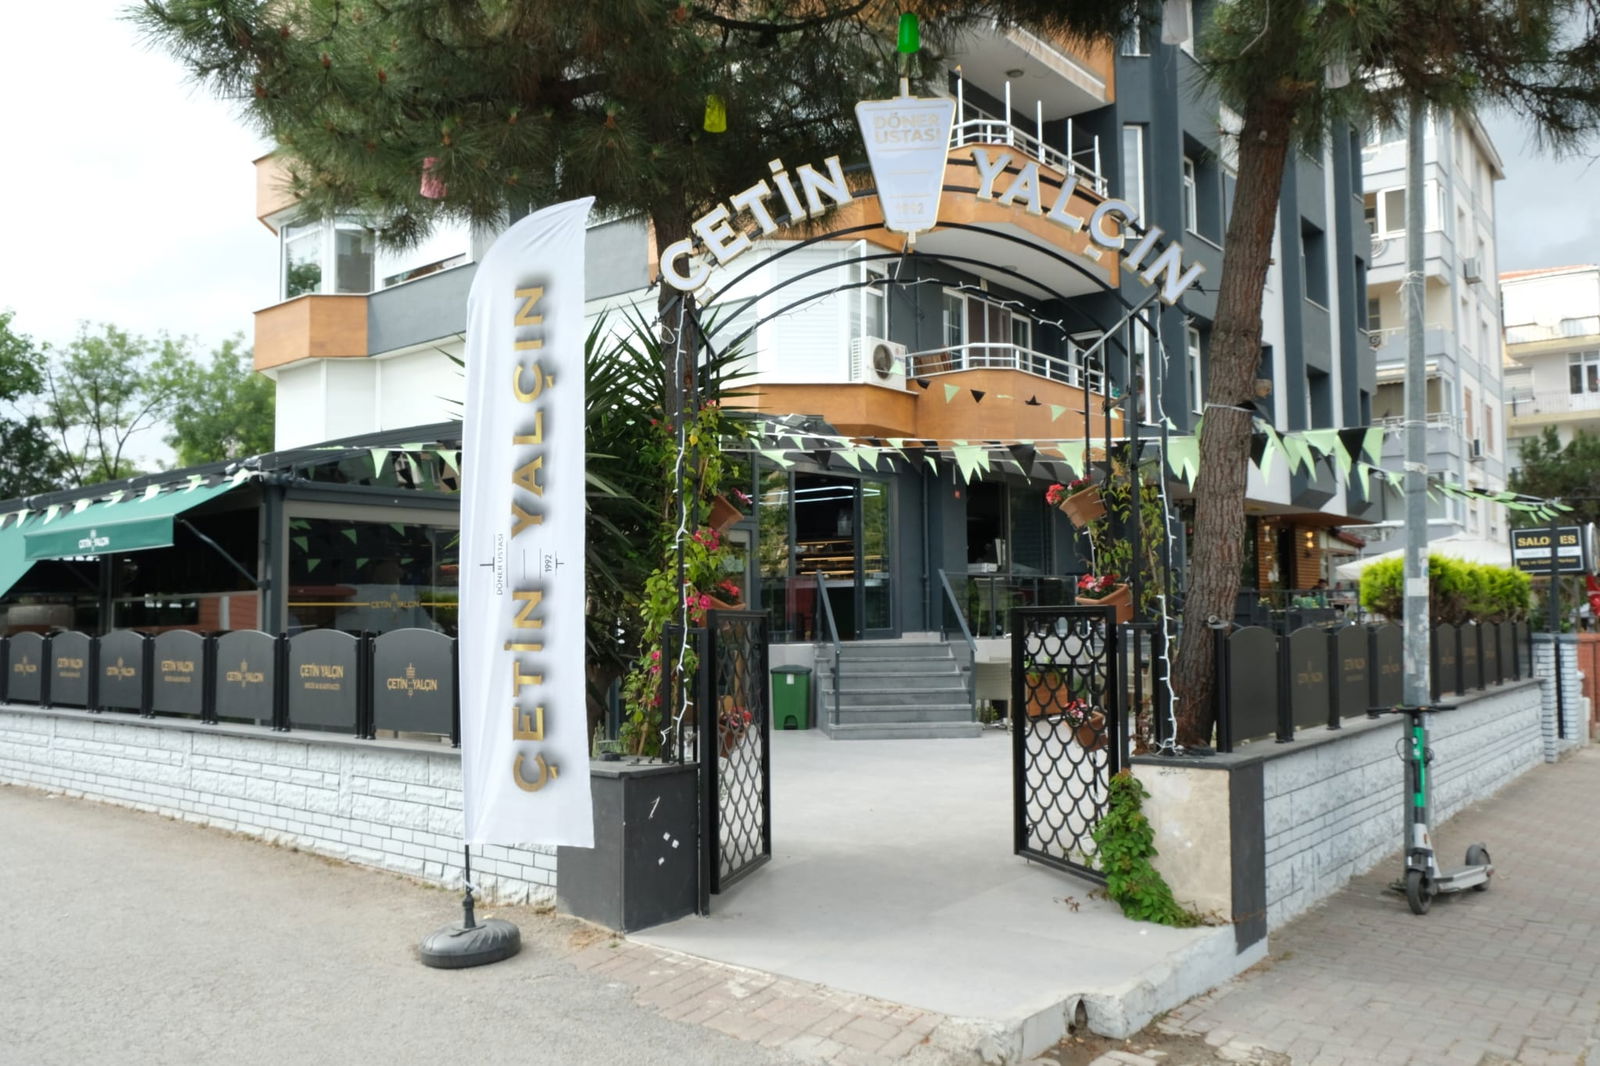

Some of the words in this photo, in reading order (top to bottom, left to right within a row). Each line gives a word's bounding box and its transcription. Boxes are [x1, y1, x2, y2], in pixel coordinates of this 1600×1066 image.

[969, 147, 1208, 306] YALÇIN
[510, 285, 556, 540] YALÇIN
[544, 554, 553, 572] 1992
[504, 590, 559, 793] ÇETİN
